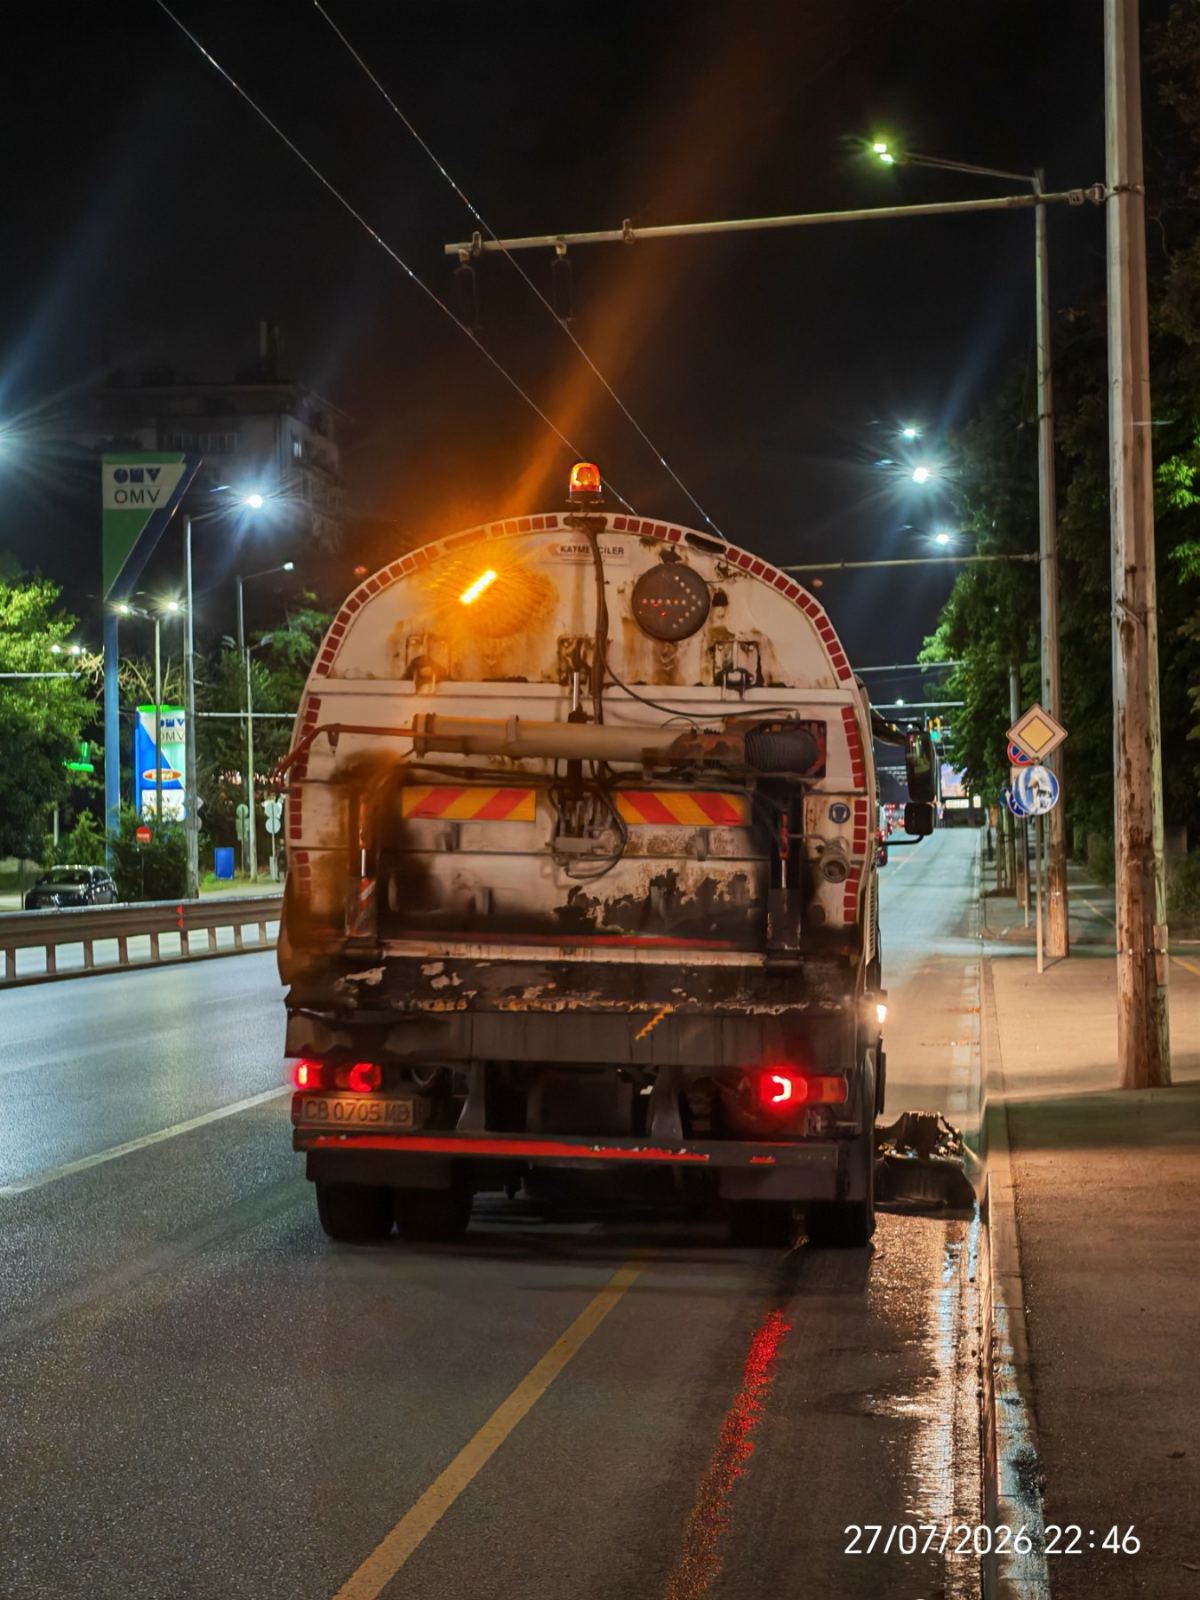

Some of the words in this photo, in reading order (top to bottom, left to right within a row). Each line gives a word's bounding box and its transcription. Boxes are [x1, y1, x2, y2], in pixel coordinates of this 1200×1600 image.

[114, 489, 160, 504] OMV
[560, 544, 624, 555] KATMECİLER
[334, 1101, 381, 1122] 0705
